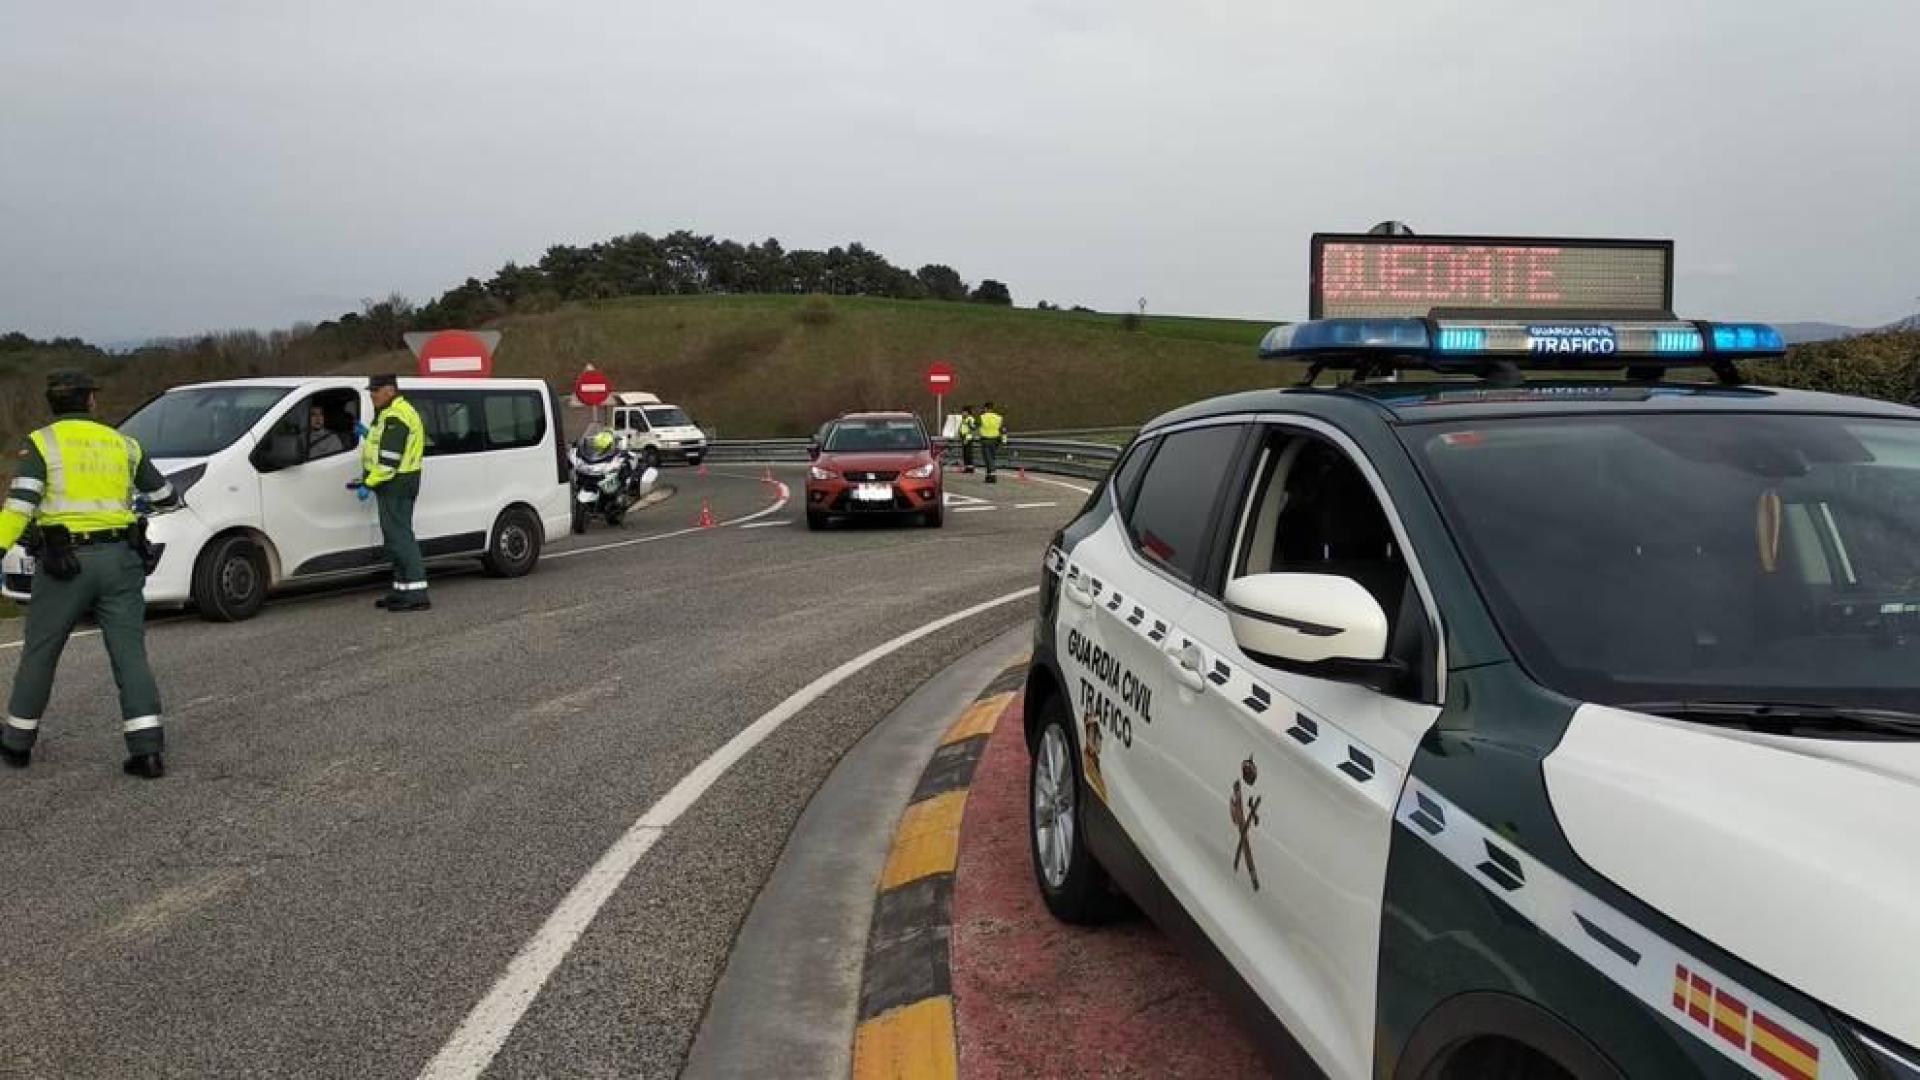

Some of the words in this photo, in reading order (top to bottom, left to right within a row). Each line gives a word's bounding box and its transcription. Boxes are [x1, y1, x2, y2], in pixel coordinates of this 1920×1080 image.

[1322, 244, 1561, 299] QUEDATE
[1535, 337, 1615, 353] TRAFICO
[1068, 628, 1120, 693] GUARDIA
[1122, 670, 1151, 724] CIVIL
[1080, 677, 1131, 748] TRAFICO
